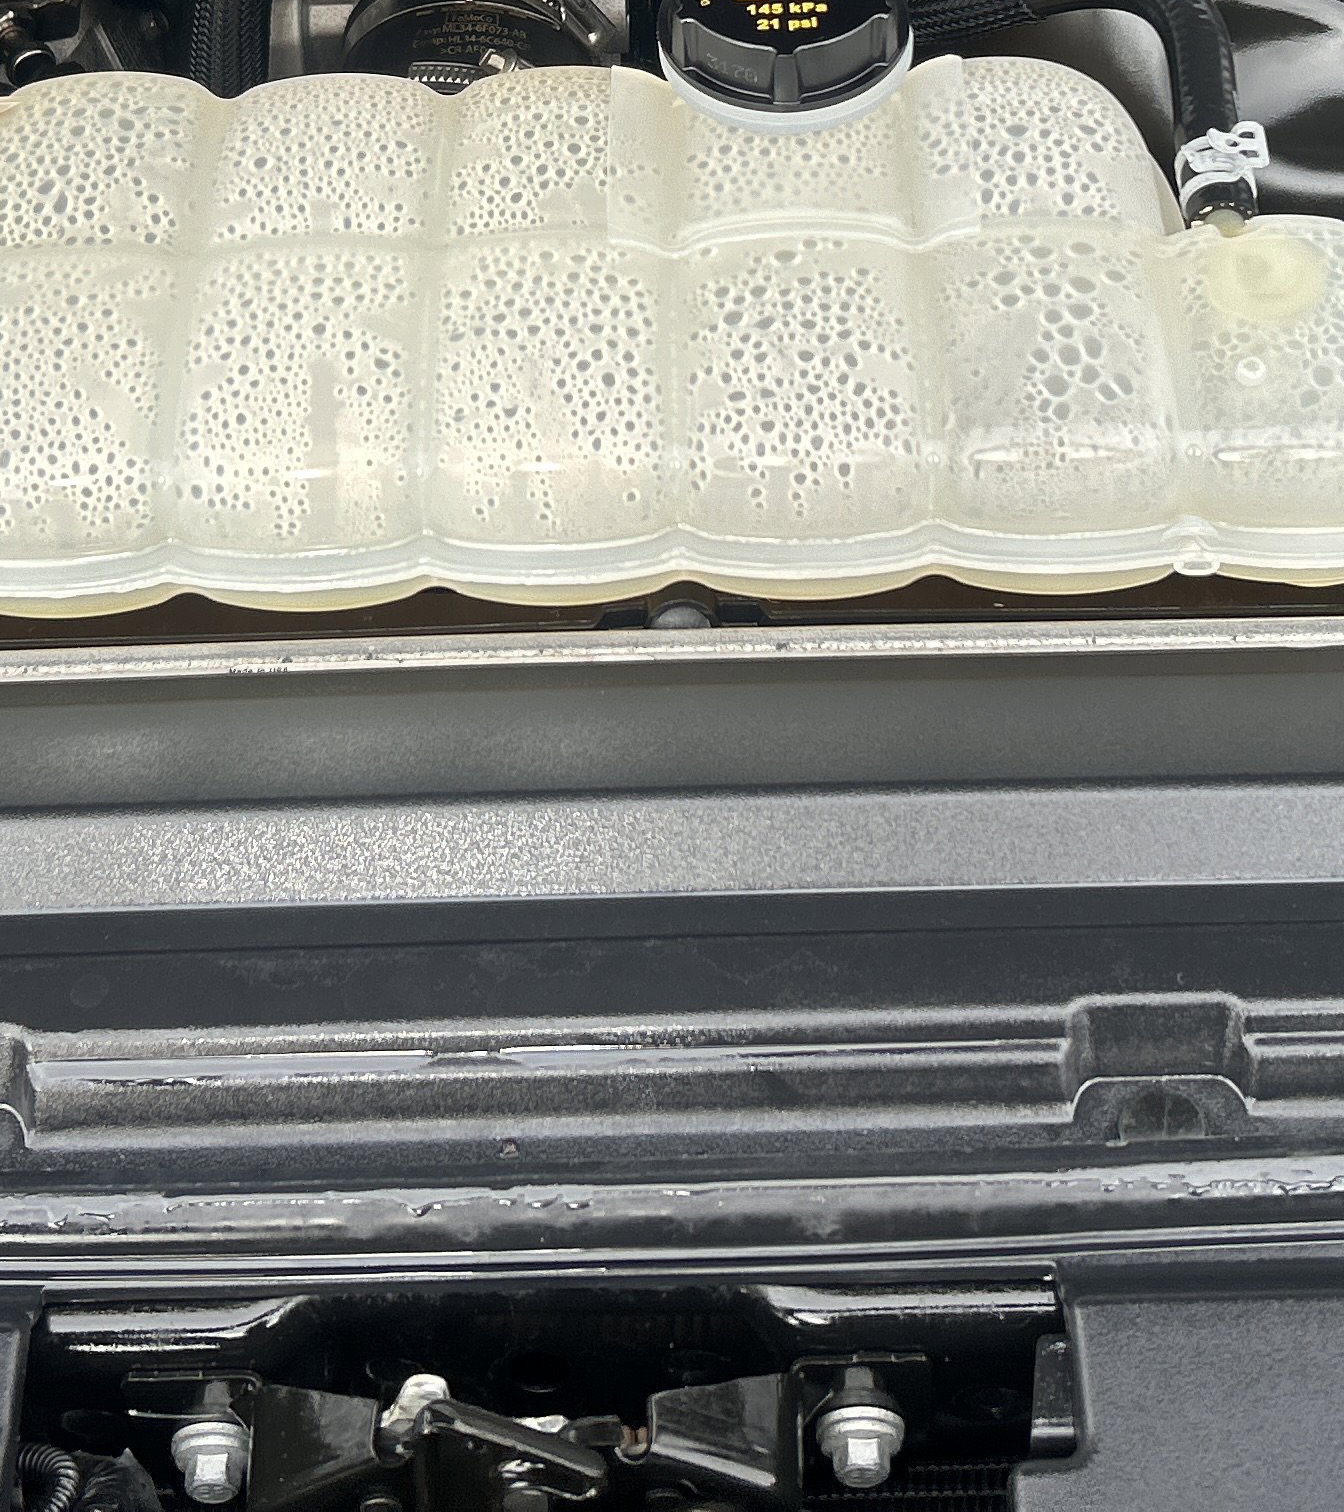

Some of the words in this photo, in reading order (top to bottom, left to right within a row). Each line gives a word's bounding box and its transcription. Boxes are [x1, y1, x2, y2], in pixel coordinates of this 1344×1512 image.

[746, 3, 784, 16] 145
[788, 2, 828, 14] kPa
[756, 18, 780, 30] 21
[788, 16, 818, 32] psi
